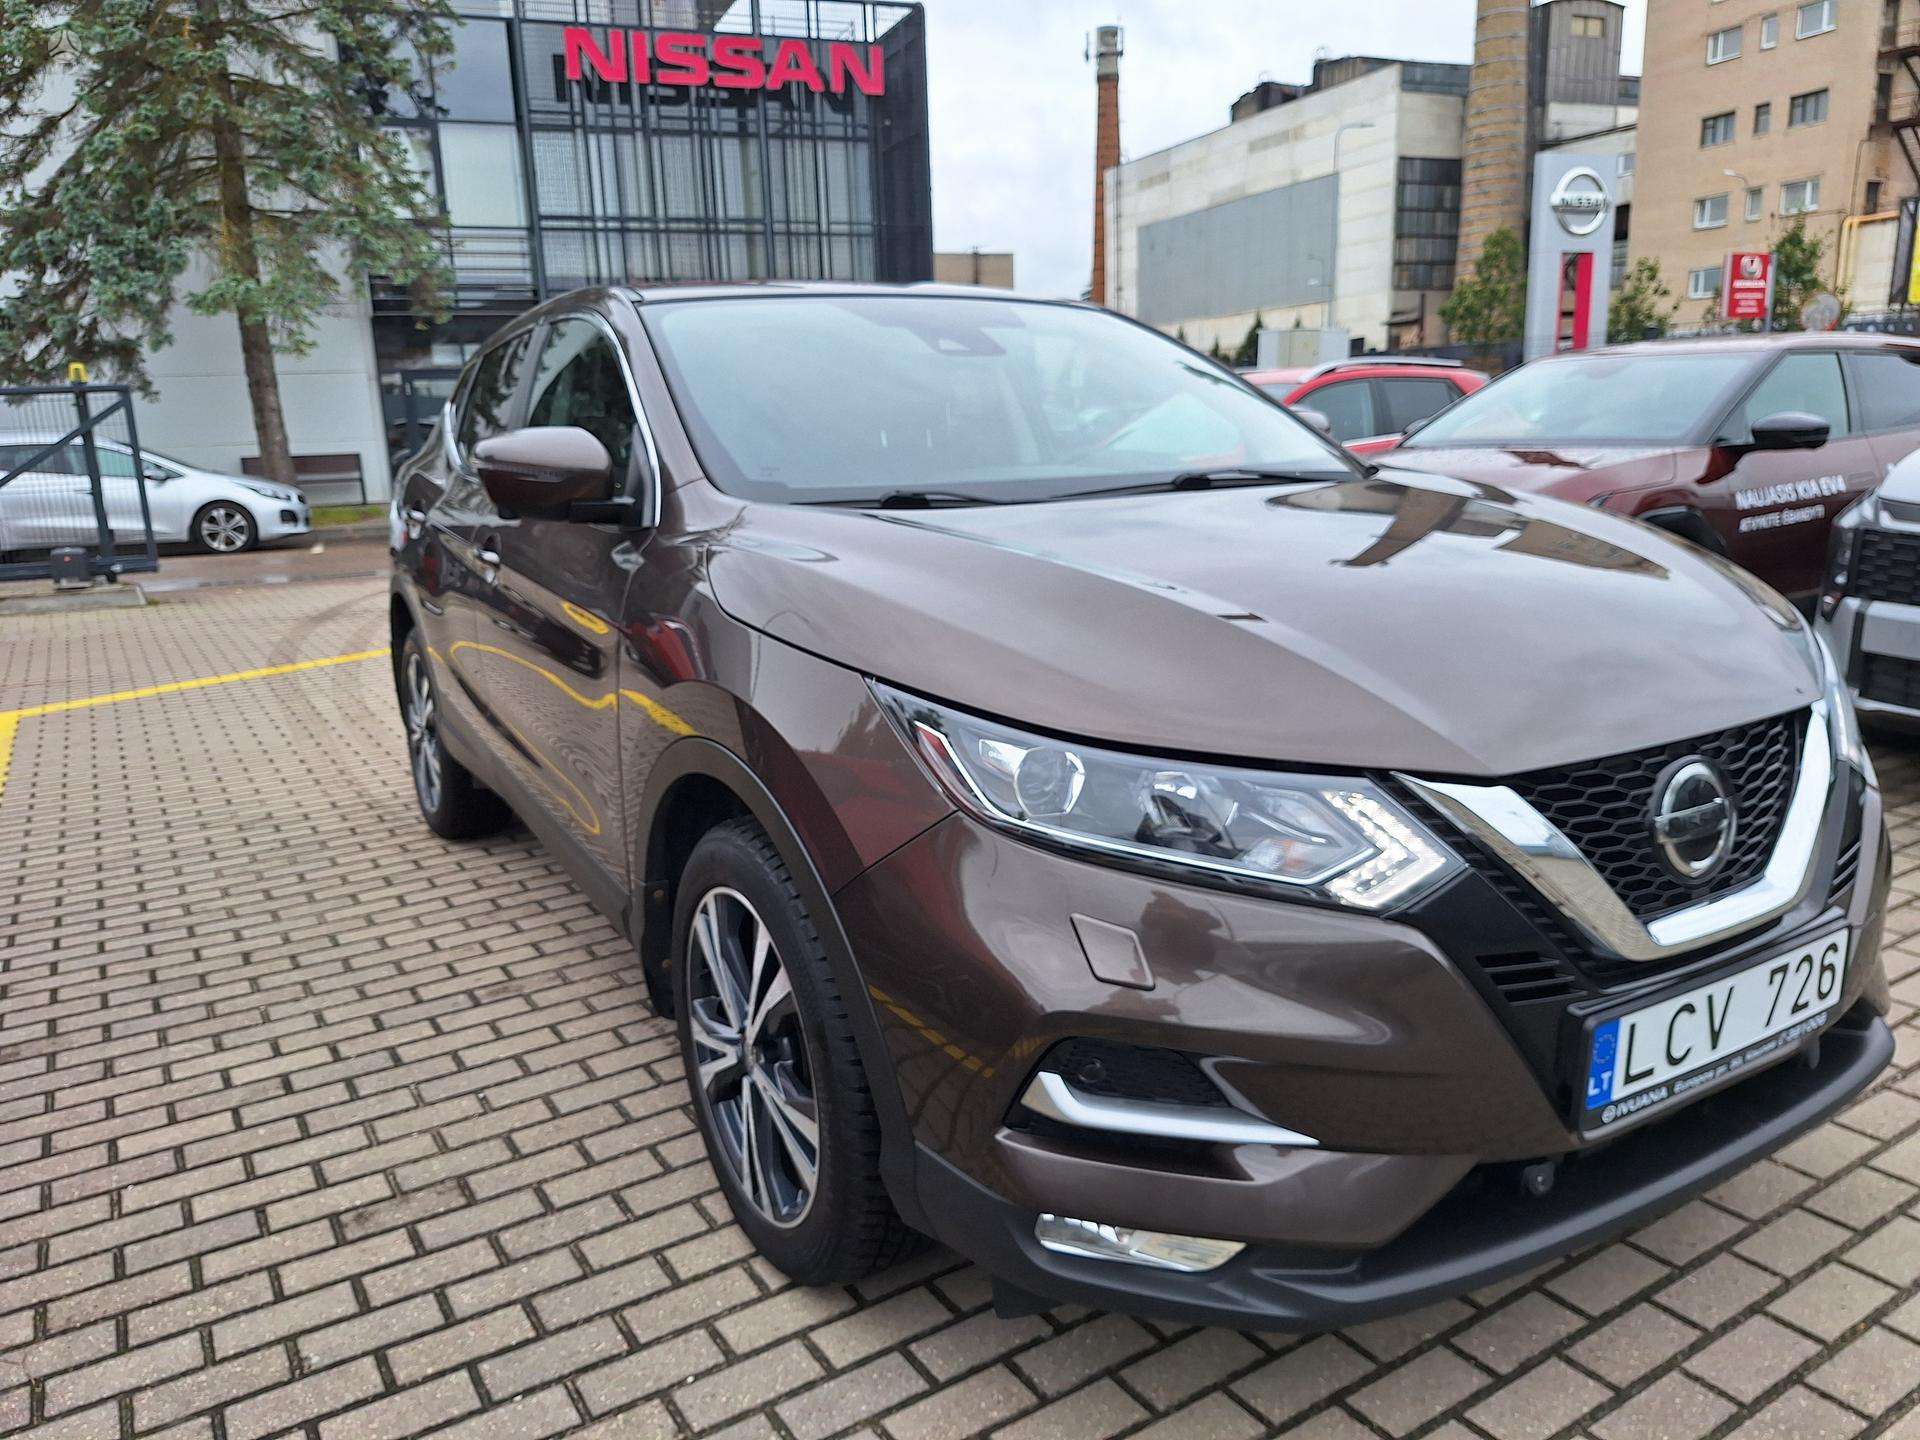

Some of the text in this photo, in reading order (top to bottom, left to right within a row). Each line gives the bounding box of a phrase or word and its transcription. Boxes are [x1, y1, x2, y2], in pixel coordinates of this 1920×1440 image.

[563, 27, 886, 96] NISSAN
[1623, 942, 1839, 1085] LCV 726
[1587, 1070, 1613, 1098] LT
